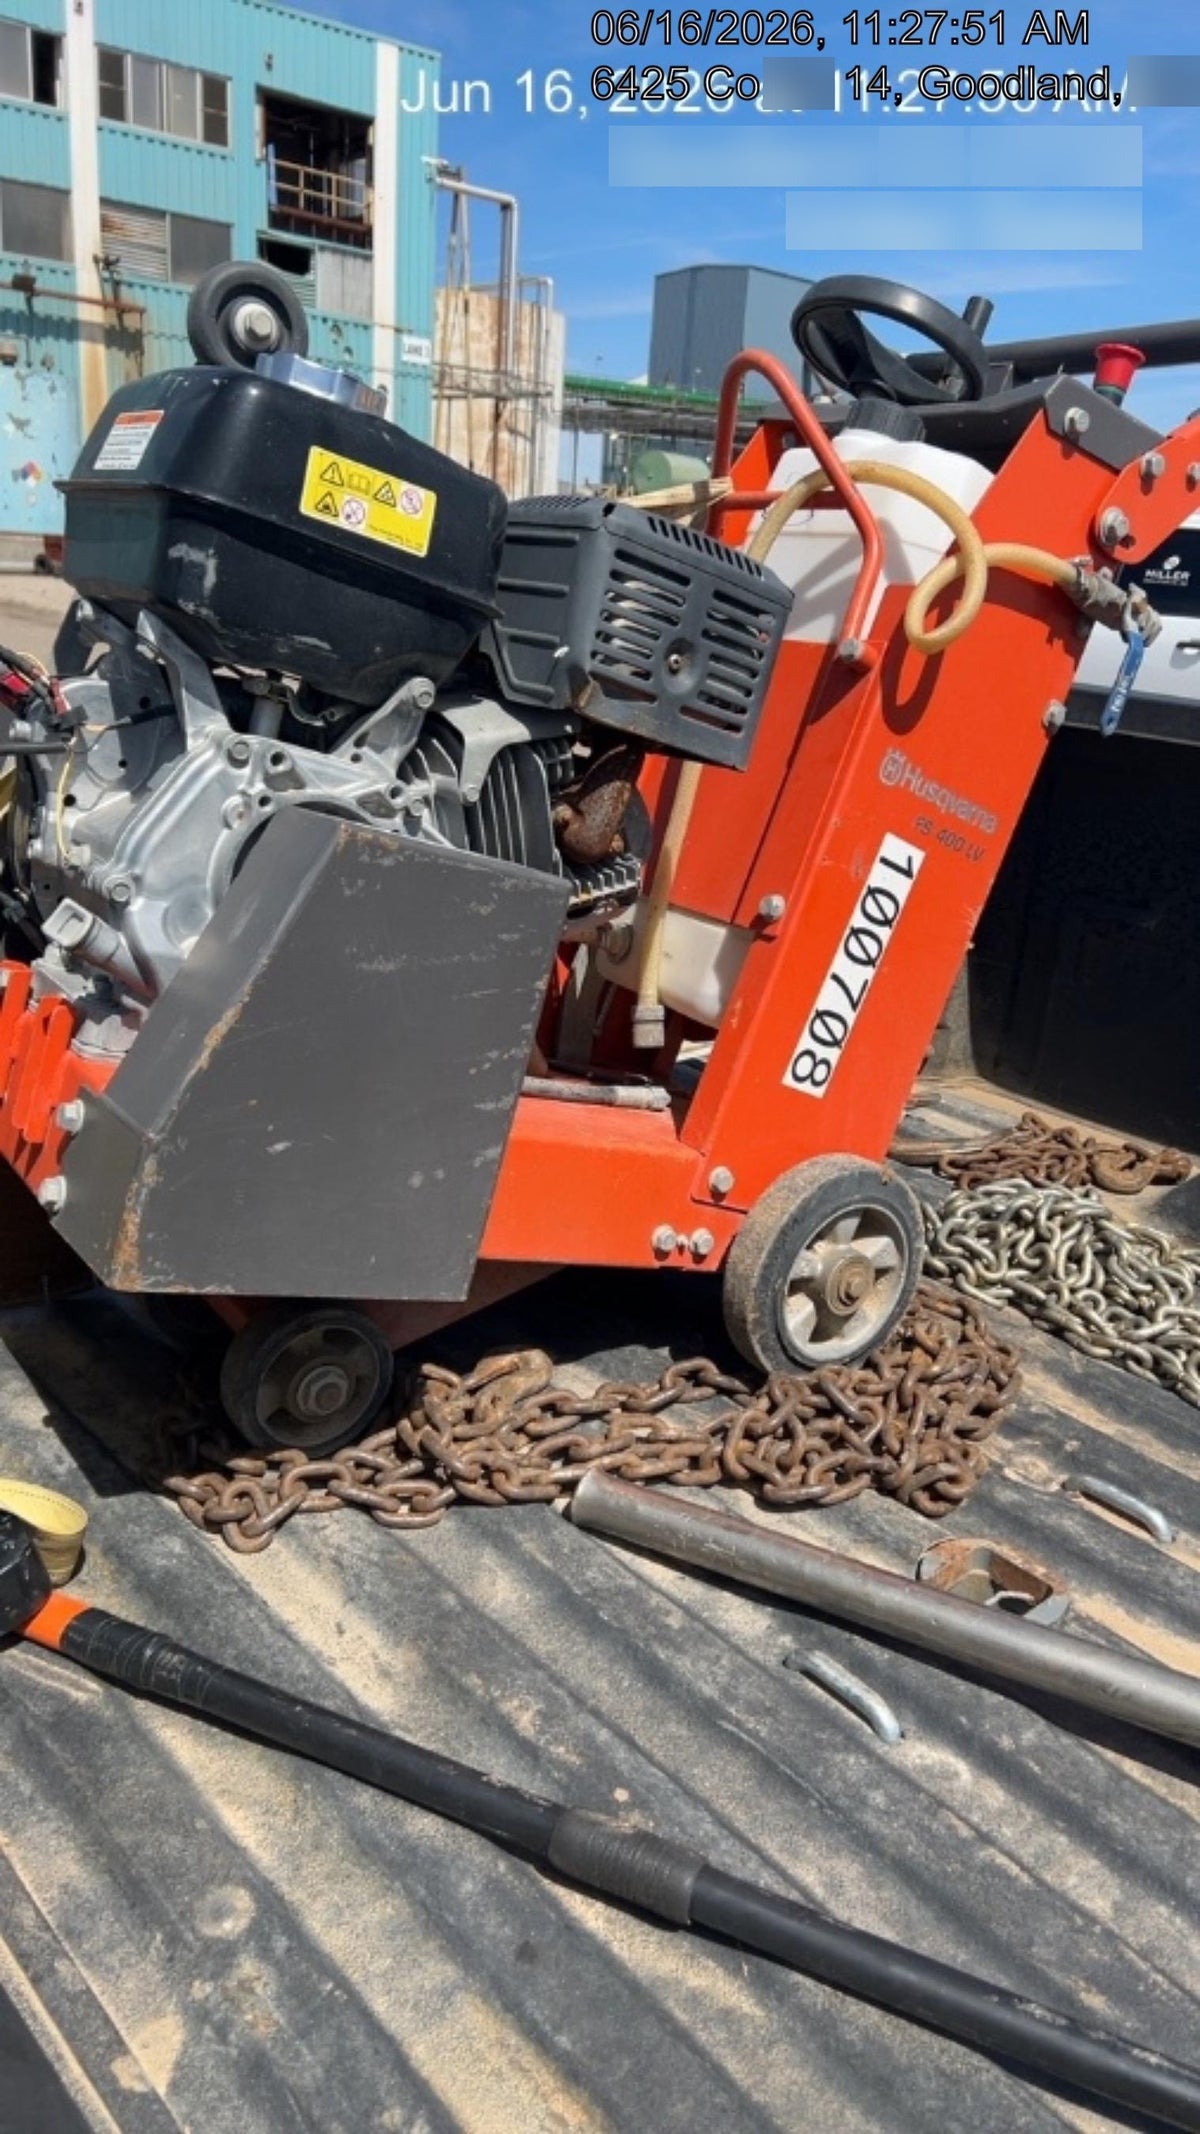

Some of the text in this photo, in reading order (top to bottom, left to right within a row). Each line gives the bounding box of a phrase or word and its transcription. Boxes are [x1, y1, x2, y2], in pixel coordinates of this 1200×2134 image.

[1145, 569, 1190, 581] MILLER
[900, 761, 998, 836] Husqvarna
[791, 854, 914, 1087] 100708
